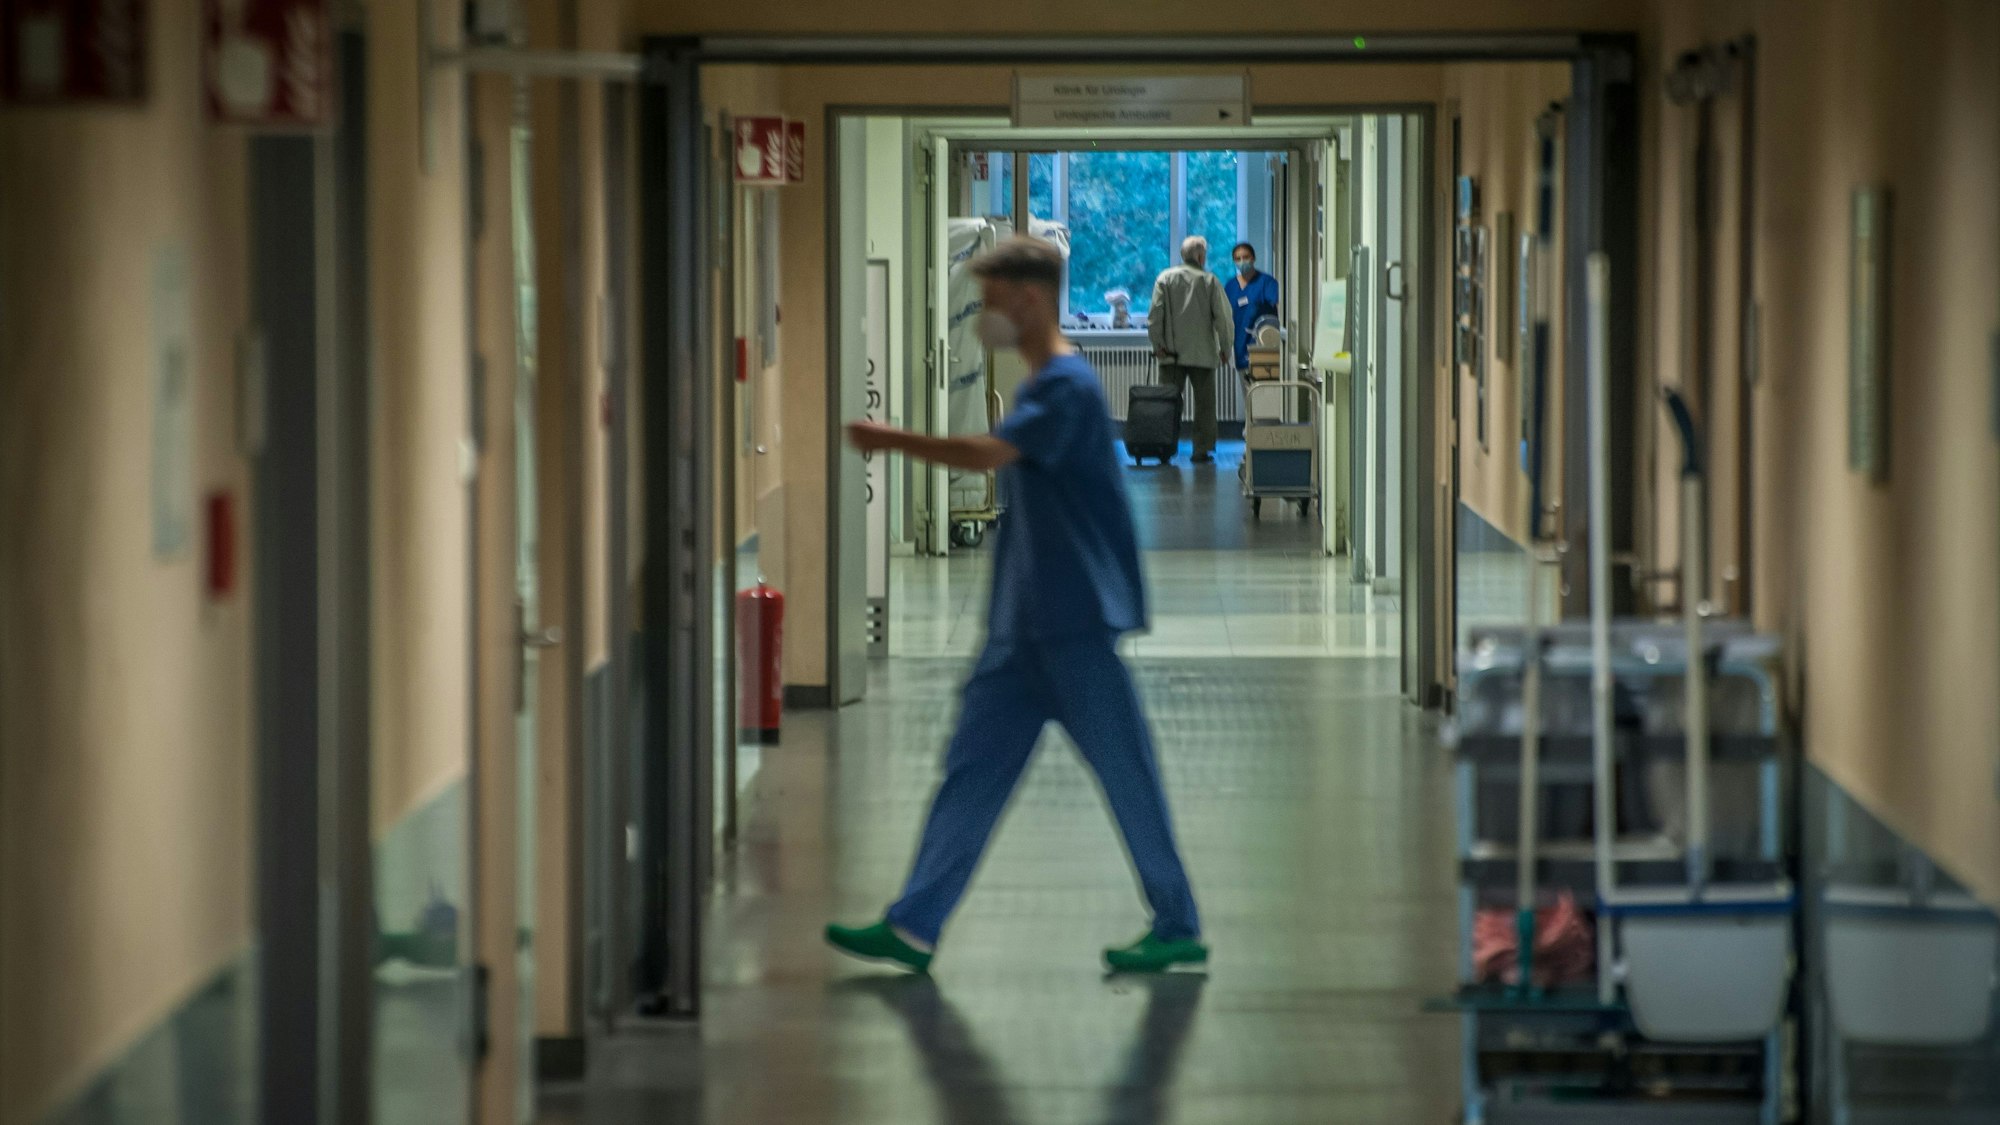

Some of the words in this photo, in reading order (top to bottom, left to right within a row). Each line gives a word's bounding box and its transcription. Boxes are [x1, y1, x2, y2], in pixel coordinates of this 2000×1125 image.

[1054, 85, 1081, 96] Klinik
[1102, 85, 1146, 98] Urologie
[1054, 110, 1115, 122] Urologische
[1119, 110, 1171, 120] Ambulanz
